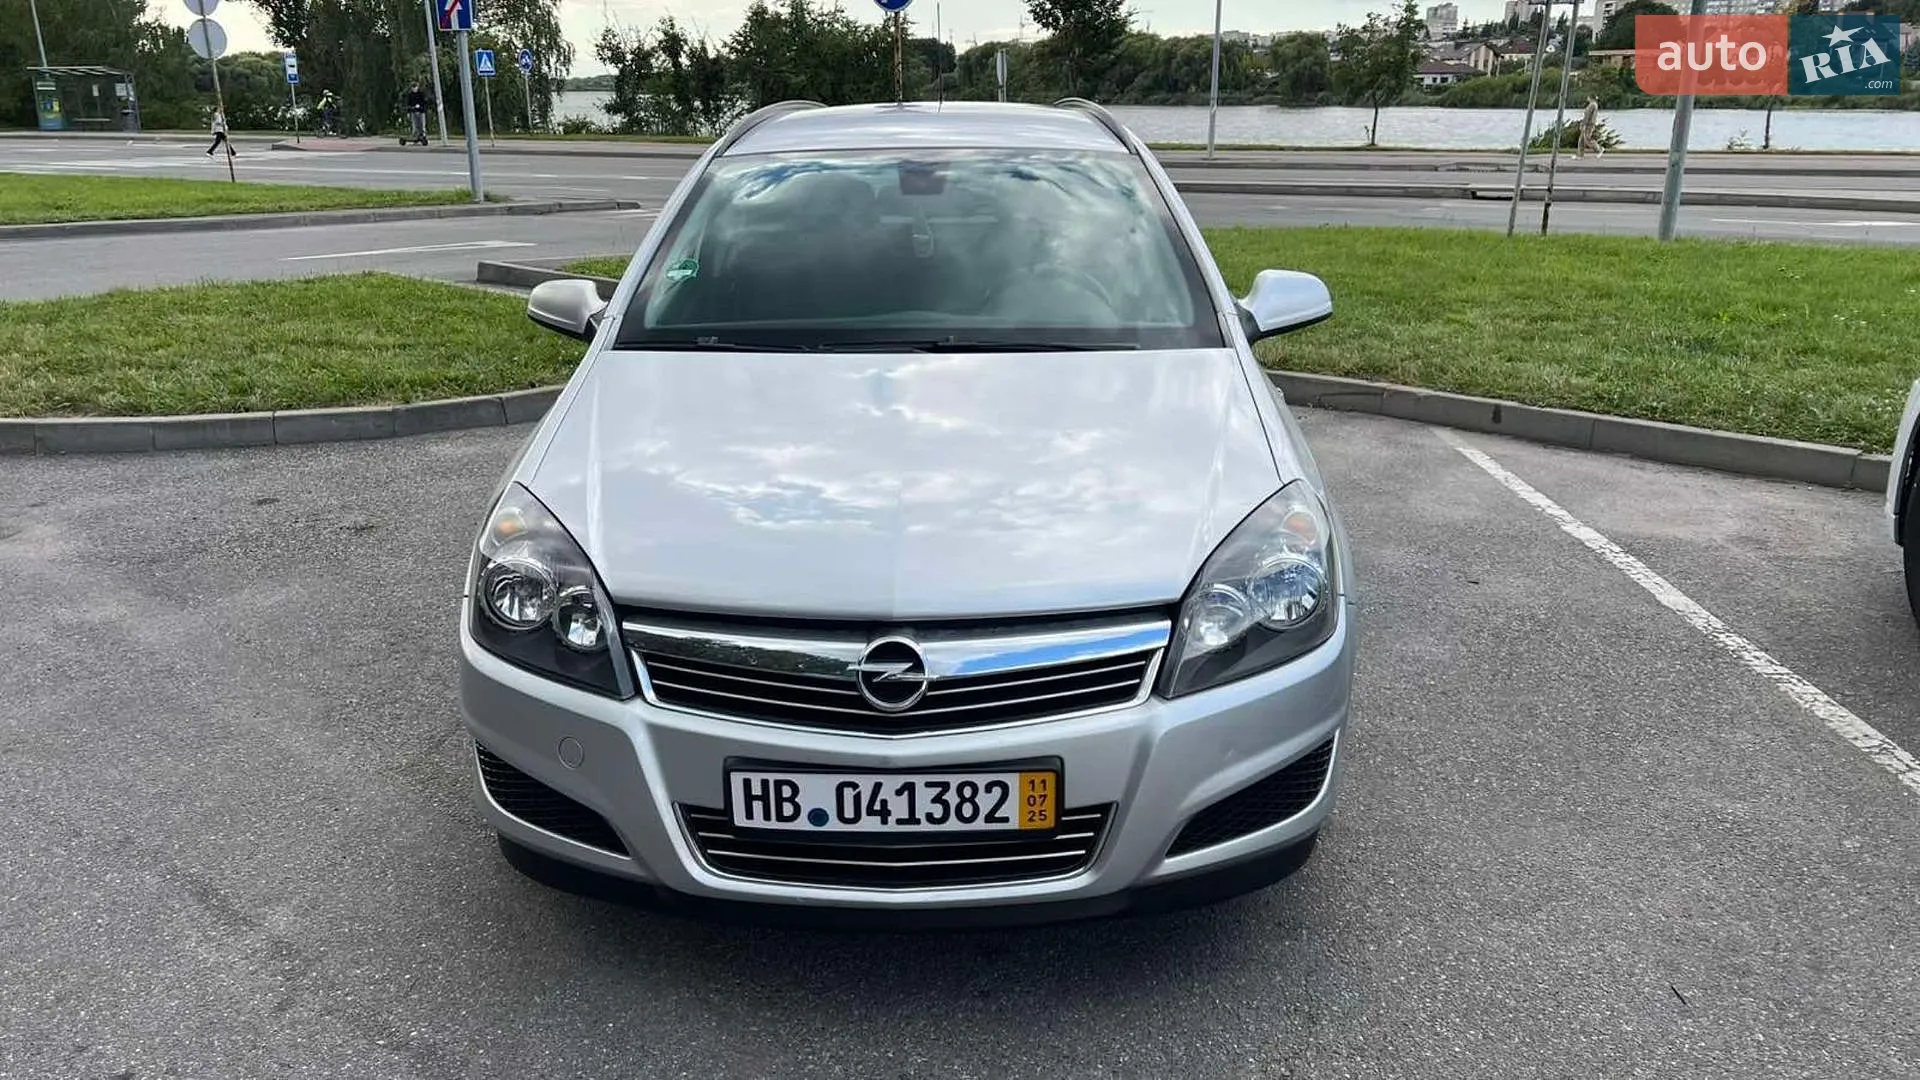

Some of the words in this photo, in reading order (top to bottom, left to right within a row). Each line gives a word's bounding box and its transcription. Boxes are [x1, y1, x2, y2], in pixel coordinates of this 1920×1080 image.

[1027, 779, 1047, 791] 11
[742, 777, 802, 822] HB
[835, 779, 1010, 825] 041382
[1026, 794, 1048, 807] 07
[1026, 809, 1048, 822] 25
